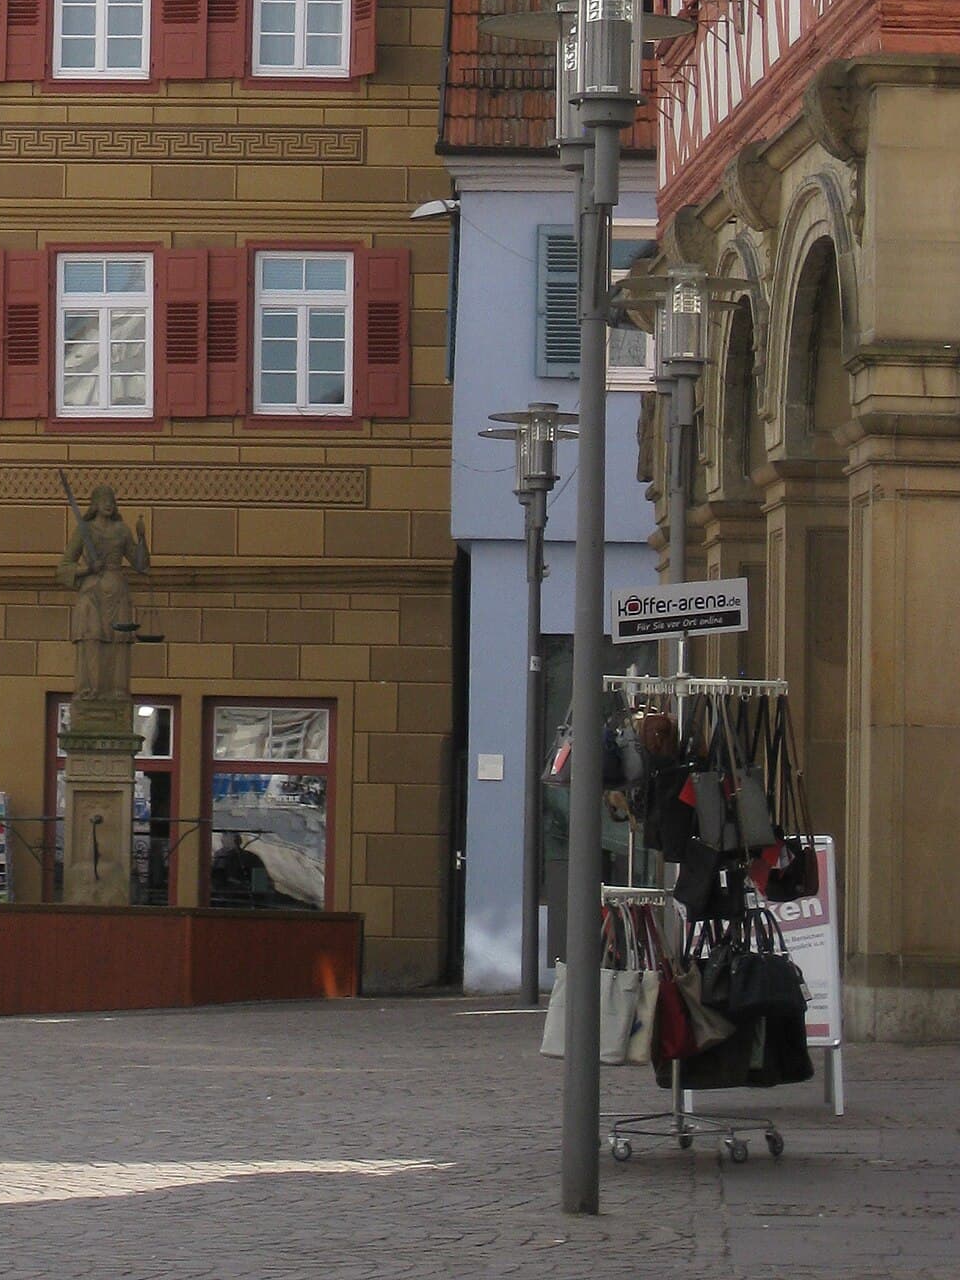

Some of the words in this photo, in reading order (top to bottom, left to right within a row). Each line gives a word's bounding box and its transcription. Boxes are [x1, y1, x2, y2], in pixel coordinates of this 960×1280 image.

[637, 622, 649, 631] Für
[653, 621, 665, 630] Sie
[683, 618, 697, 627] Ort
